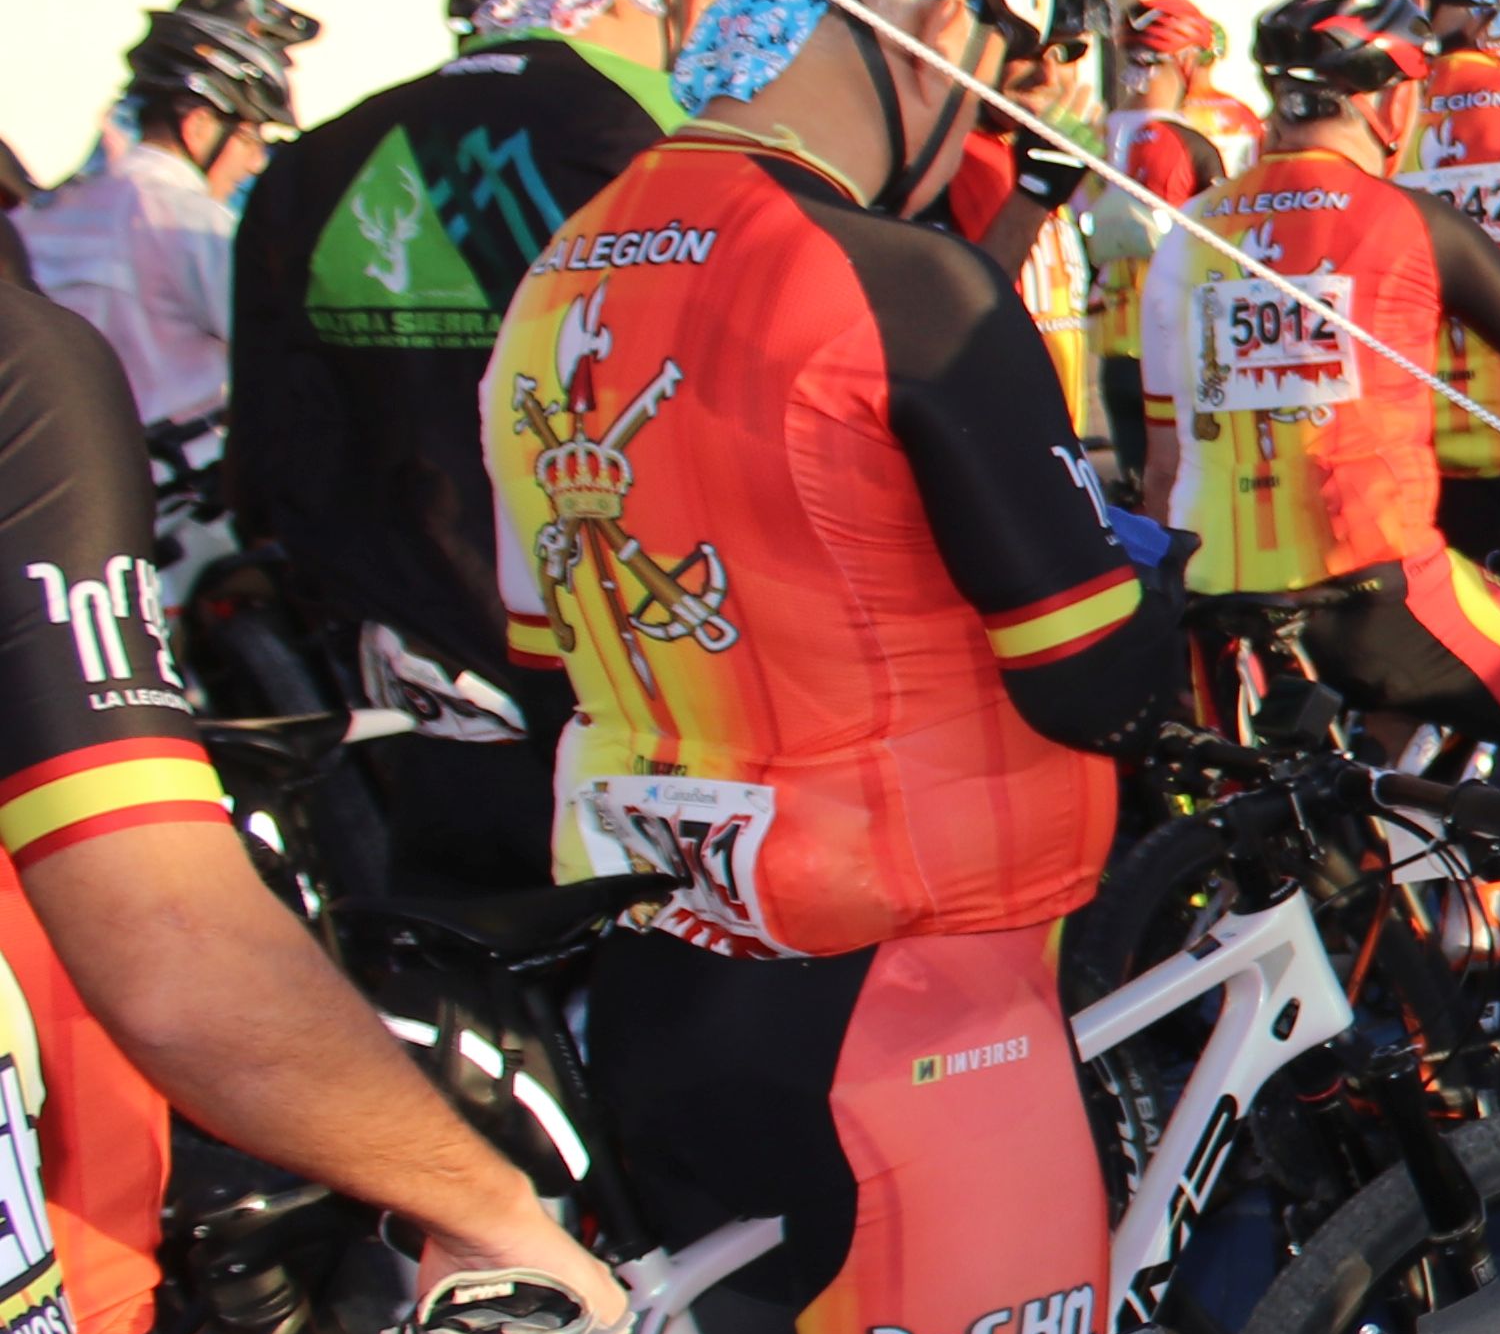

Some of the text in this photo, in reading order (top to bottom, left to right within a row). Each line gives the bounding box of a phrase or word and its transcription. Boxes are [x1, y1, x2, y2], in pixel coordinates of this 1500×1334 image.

[1202, 186, 1350, 220] LA LEGIÓN
[569, 220, 717, 268] LEGIÓN
[1229, 297, 1338, 350] 5012
[89, 689, 124, 711] LA
